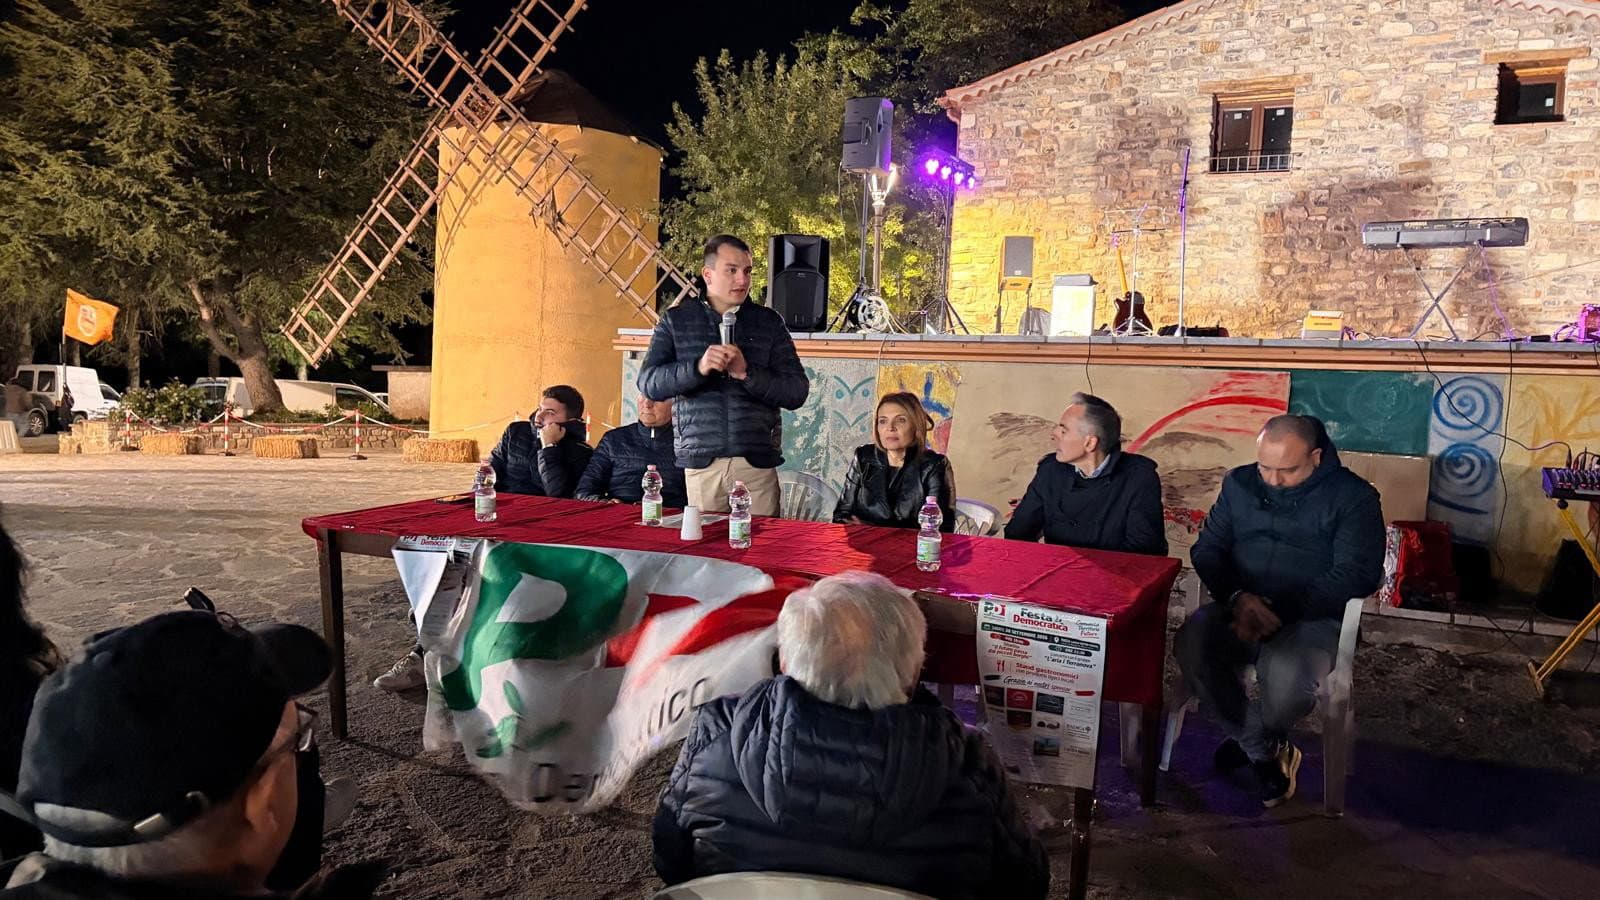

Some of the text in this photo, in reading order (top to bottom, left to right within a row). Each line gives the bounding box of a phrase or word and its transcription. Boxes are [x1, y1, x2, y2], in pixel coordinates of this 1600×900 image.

[1013, 614, 1068, 632] Democratica
[1020, 607, 1053, 621] Festa
[1015, 662, 1079, 680] Stand gastronomici
